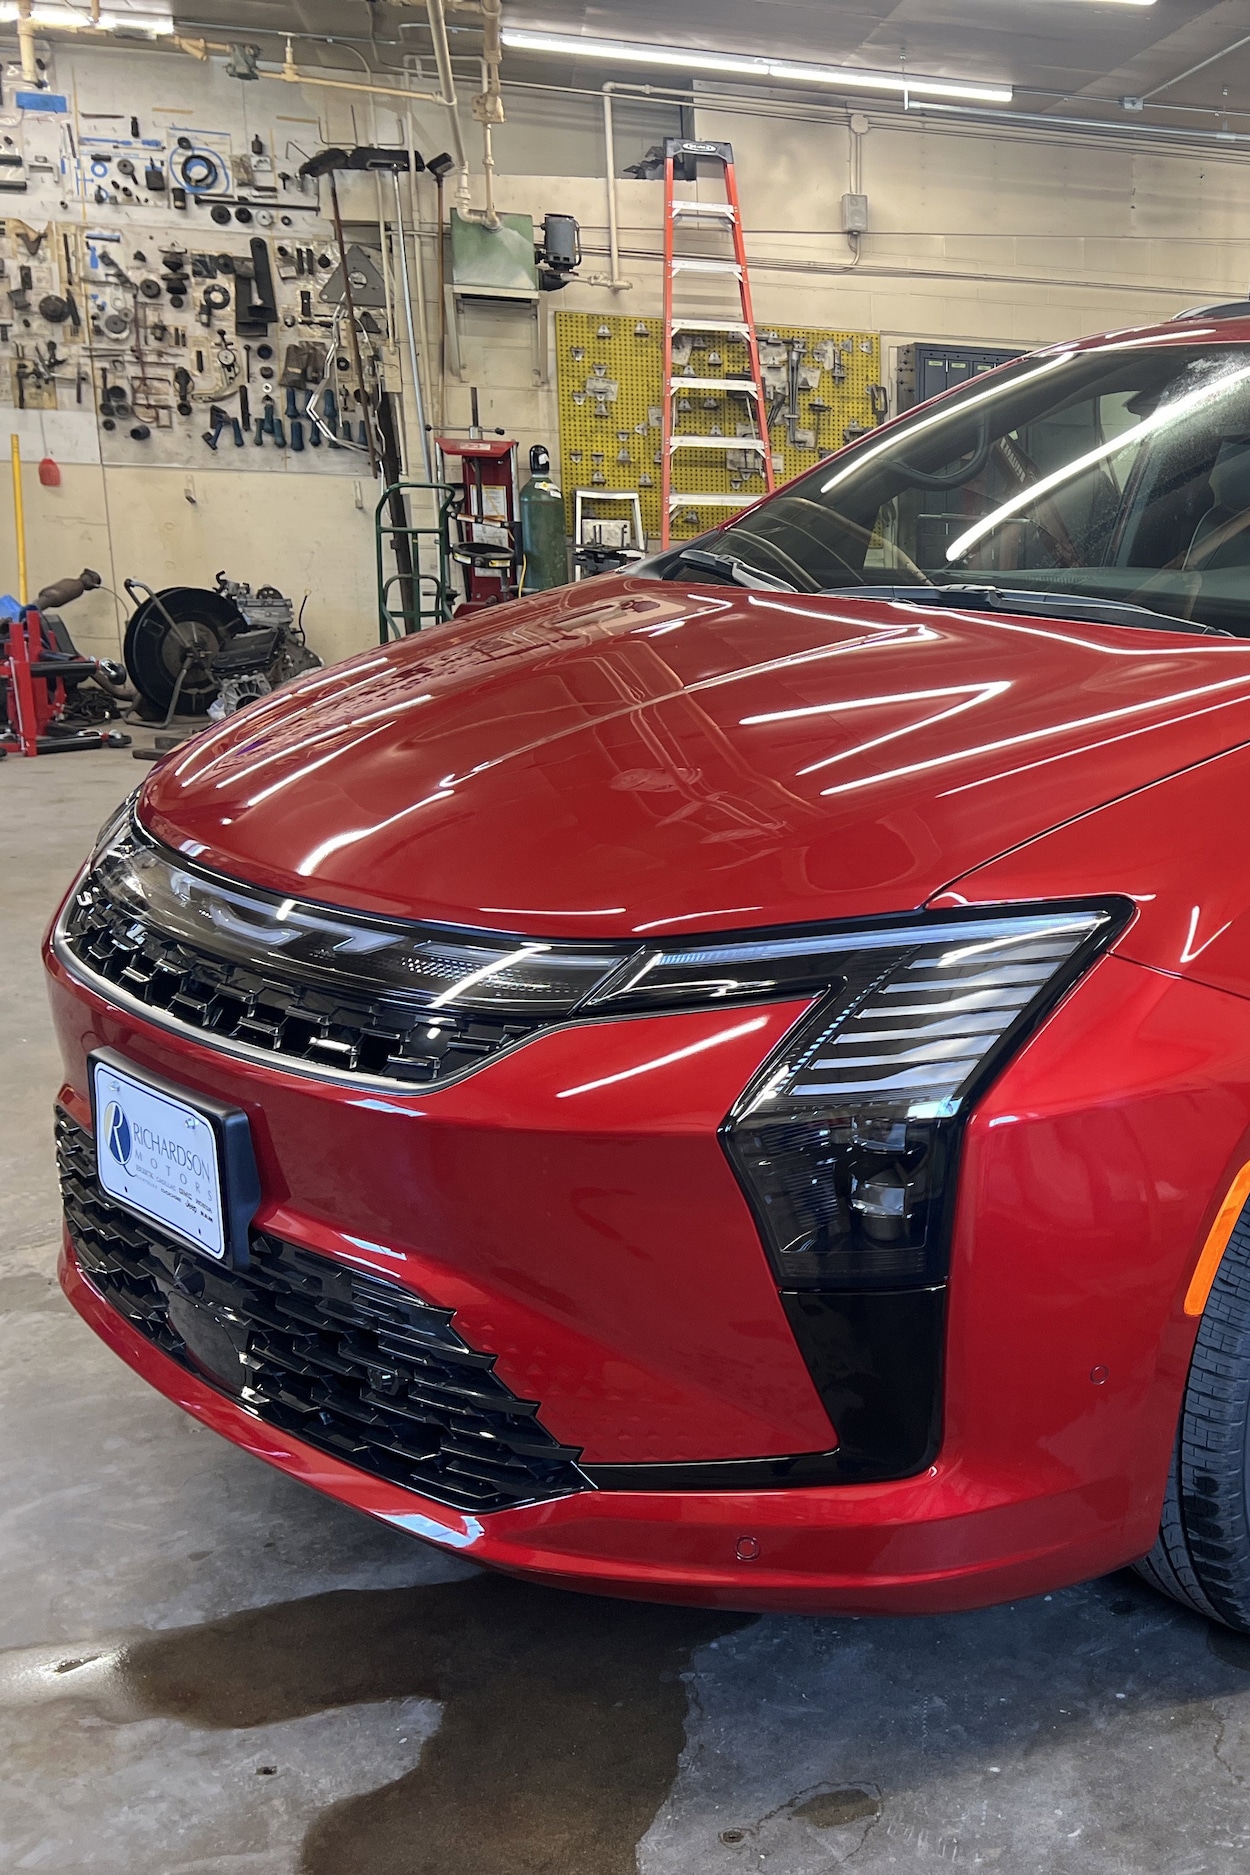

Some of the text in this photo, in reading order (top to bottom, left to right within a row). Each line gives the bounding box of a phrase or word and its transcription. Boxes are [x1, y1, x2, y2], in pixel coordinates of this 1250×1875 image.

[133, 1122, 210, 1184] RICHARDSON
[135, 1149, 213, 1202] MOTORS
[200, 1211, 213, 1223] RAM
